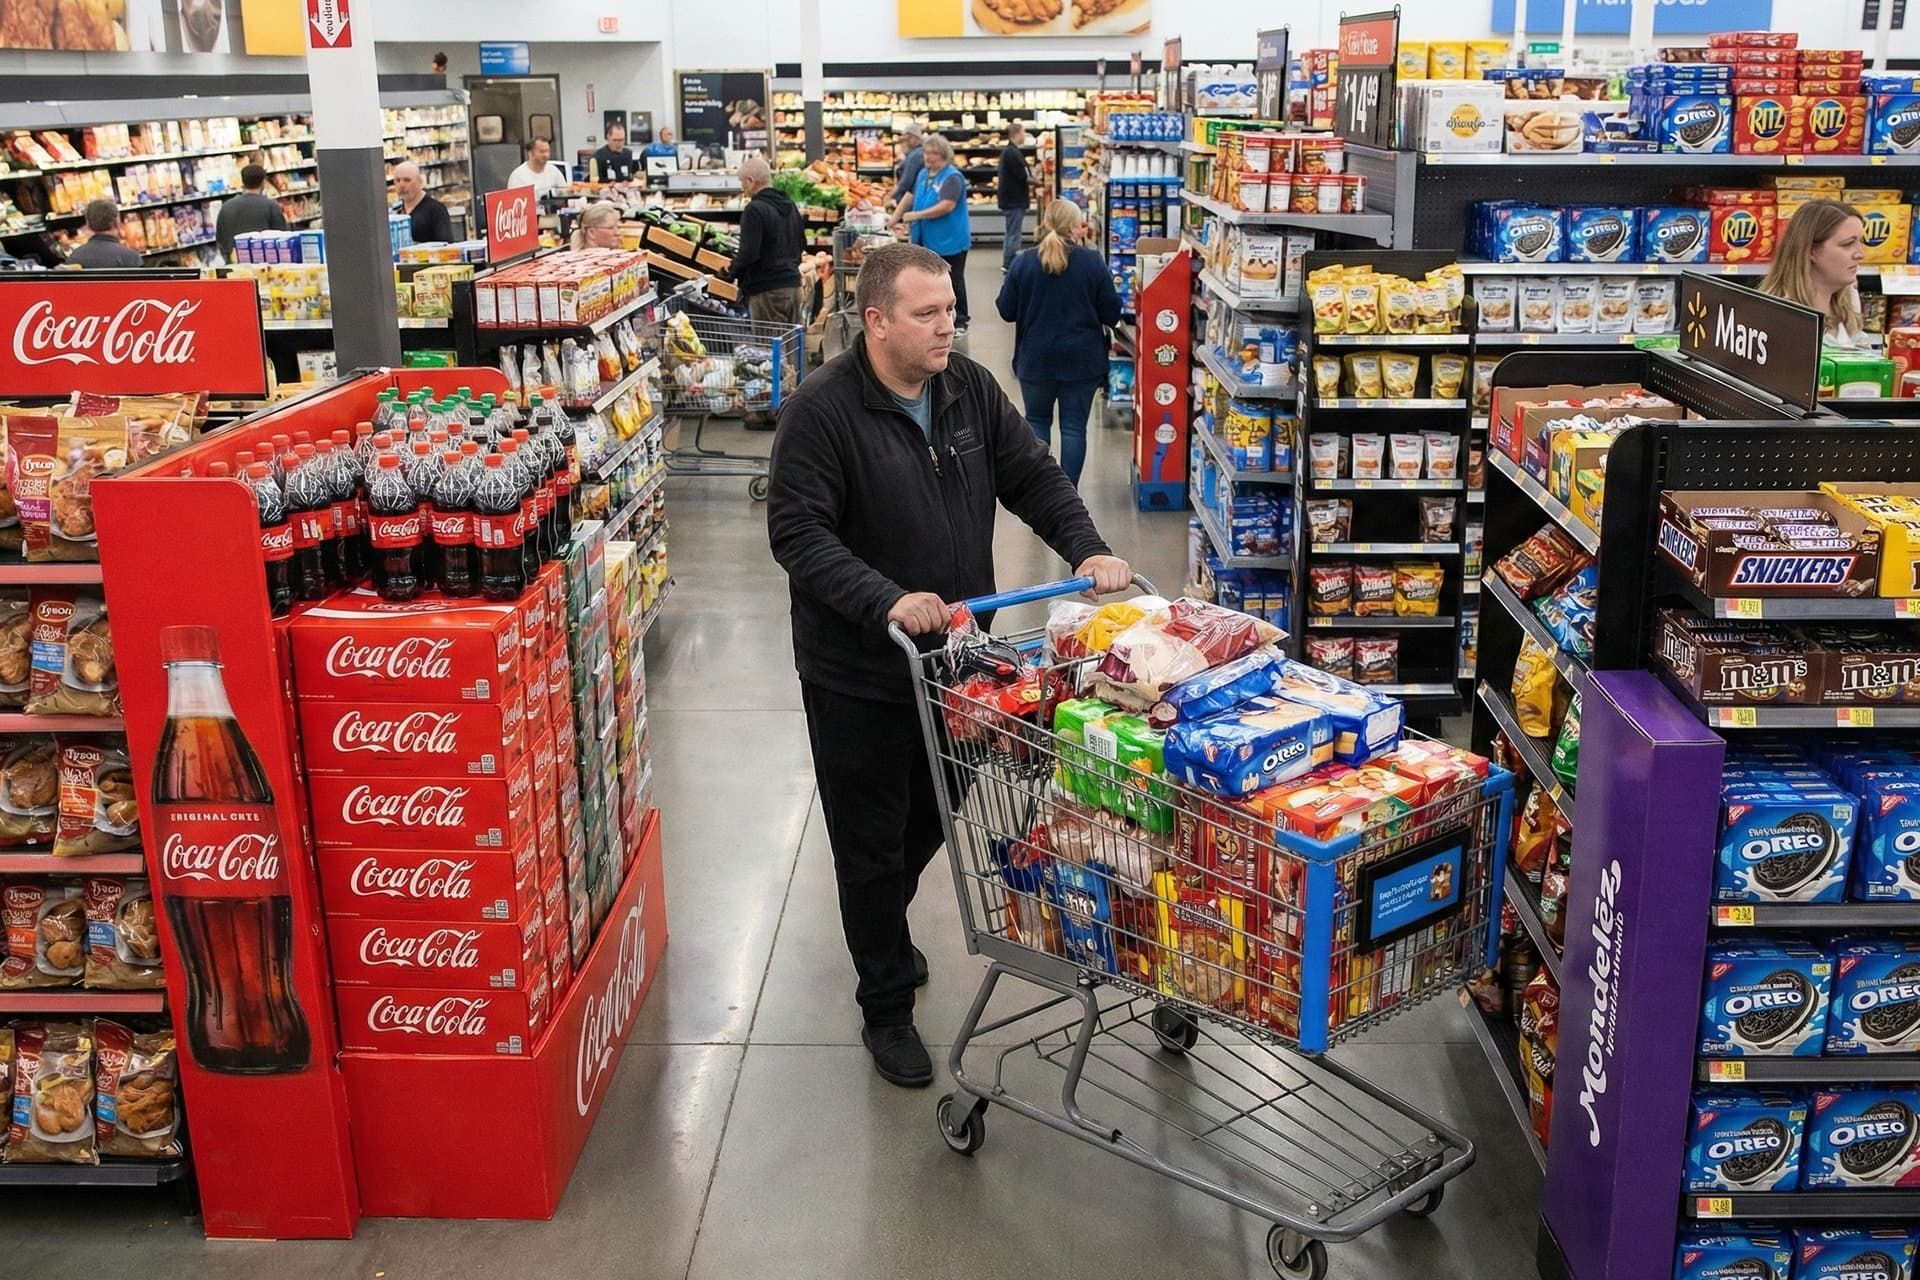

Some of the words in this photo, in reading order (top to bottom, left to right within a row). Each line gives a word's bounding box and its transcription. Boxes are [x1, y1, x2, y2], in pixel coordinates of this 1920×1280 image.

[1750, 106, 1785, 134] RITZ
[1811, 105, 1845, 134] RITZ
[1723, 218, 1757, 247] RITZ
[13, 299, 201, 365] Coca-Cola
[1715, 303, 1768, 365] Mars
[1660, 521, 1697, 569] SNICKERS
[1735, 557, 1850, 585] SNICKERS
[326, 635, 456, 679] Coca-Cola
[333, 710, 463, 754] Coca-Cola
[342, 784, 471, 827] Coca-Cola
[163, 833, 279, 881] Coca-Cola
[1741, 834, 1824, 860] OREO
[351, 858, 478, 899] Coca-Cola
[360, 927, 486, 968] Coca-Cola
[367, 995, 493, 1035] Coca-Cola
[577, 882, 646, 1116] Coca-Cola
[1724, 991, 1803, 1014] OREO
[1708, 1136, 1782, 1159] OREO
[1829, 1121, 1905, 1146] OREO
